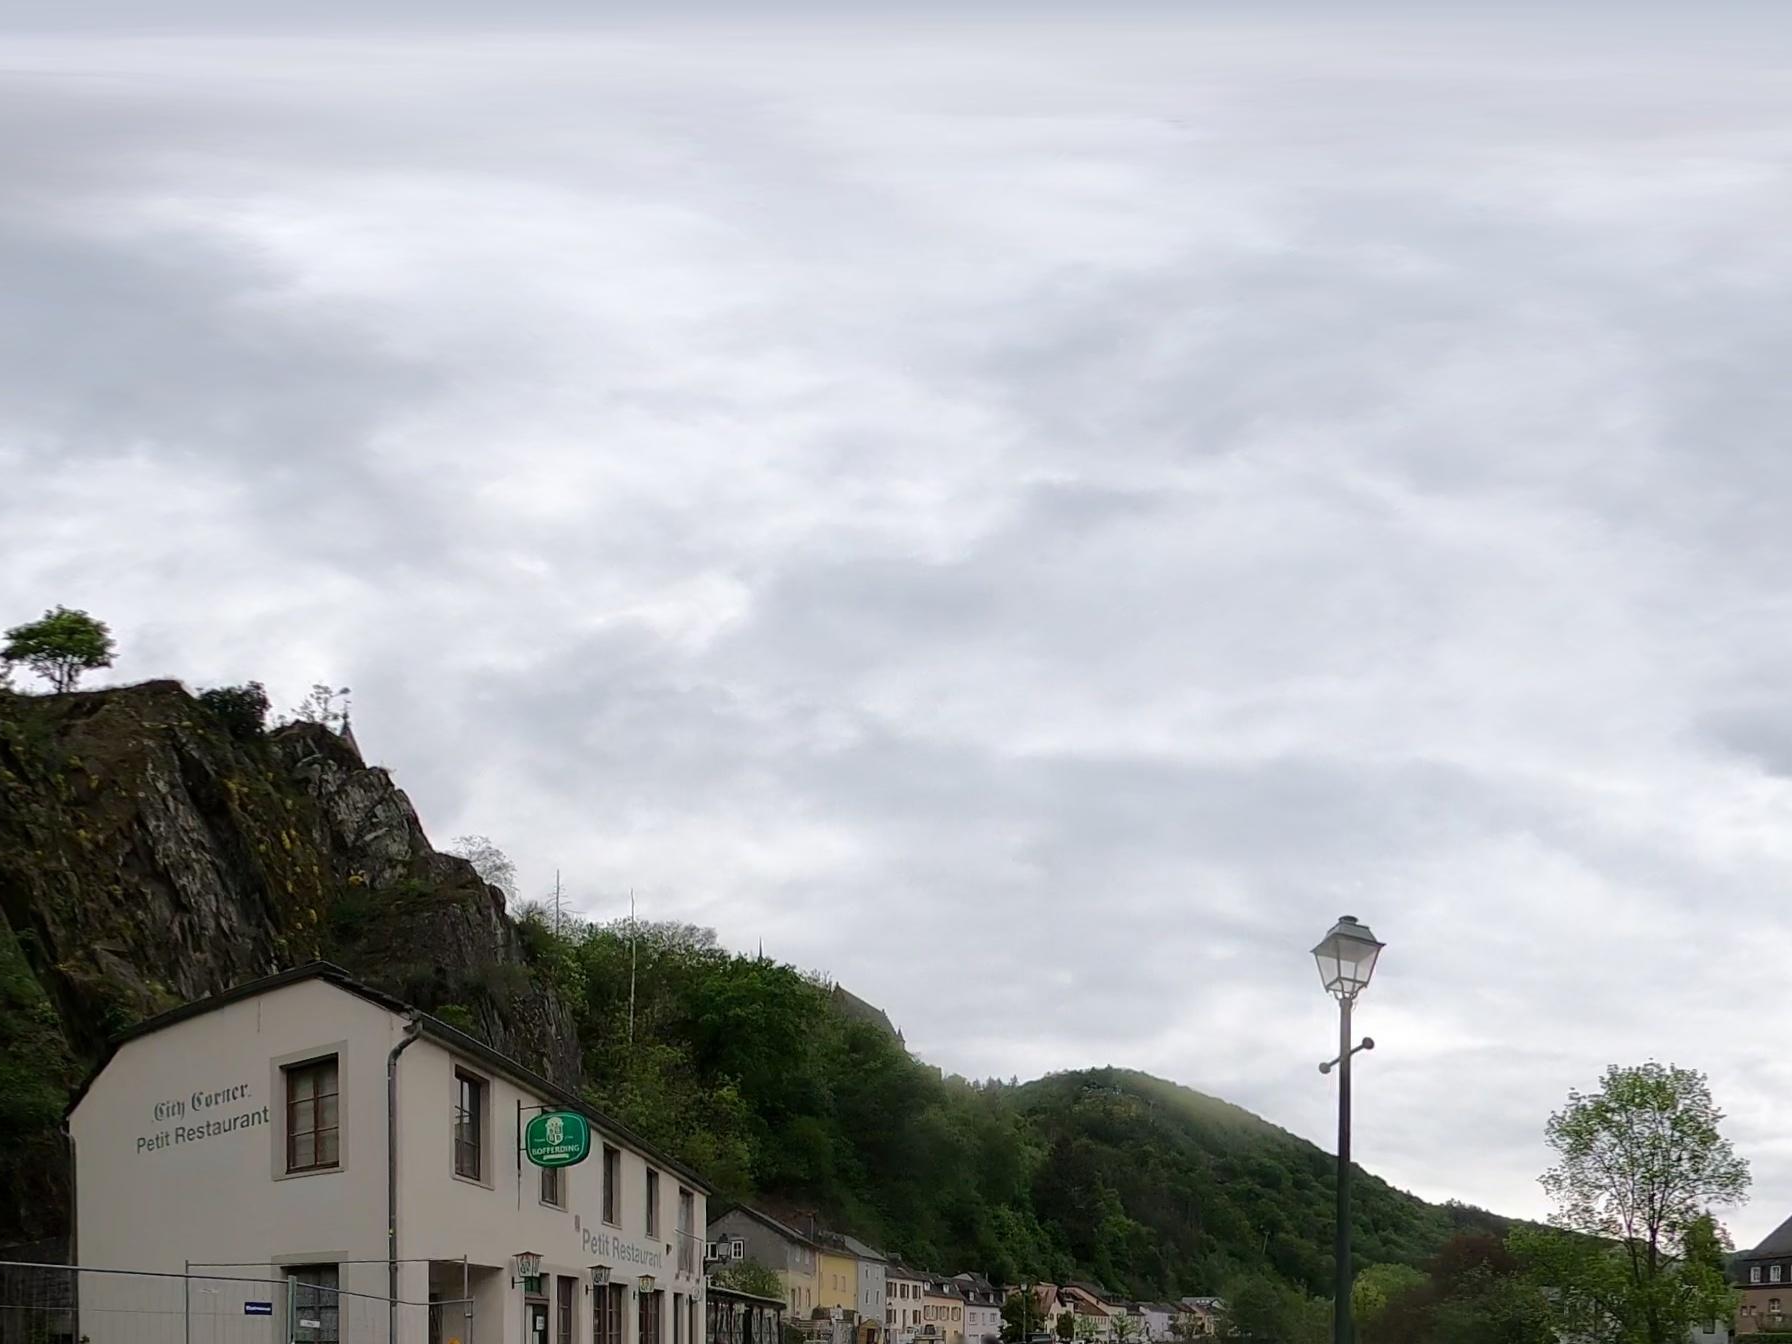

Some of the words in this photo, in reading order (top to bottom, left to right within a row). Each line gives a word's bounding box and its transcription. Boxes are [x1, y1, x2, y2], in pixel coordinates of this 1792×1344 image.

[136, 1131, 170, 1154] Petit
[175, 1105, 270, 1144] Restaurant
[532, 1144, 580, 1155] BOFFERDING
[582, 1227, 610, 1257] Petit
[612, 1236, 663, 1269] Restaurant
